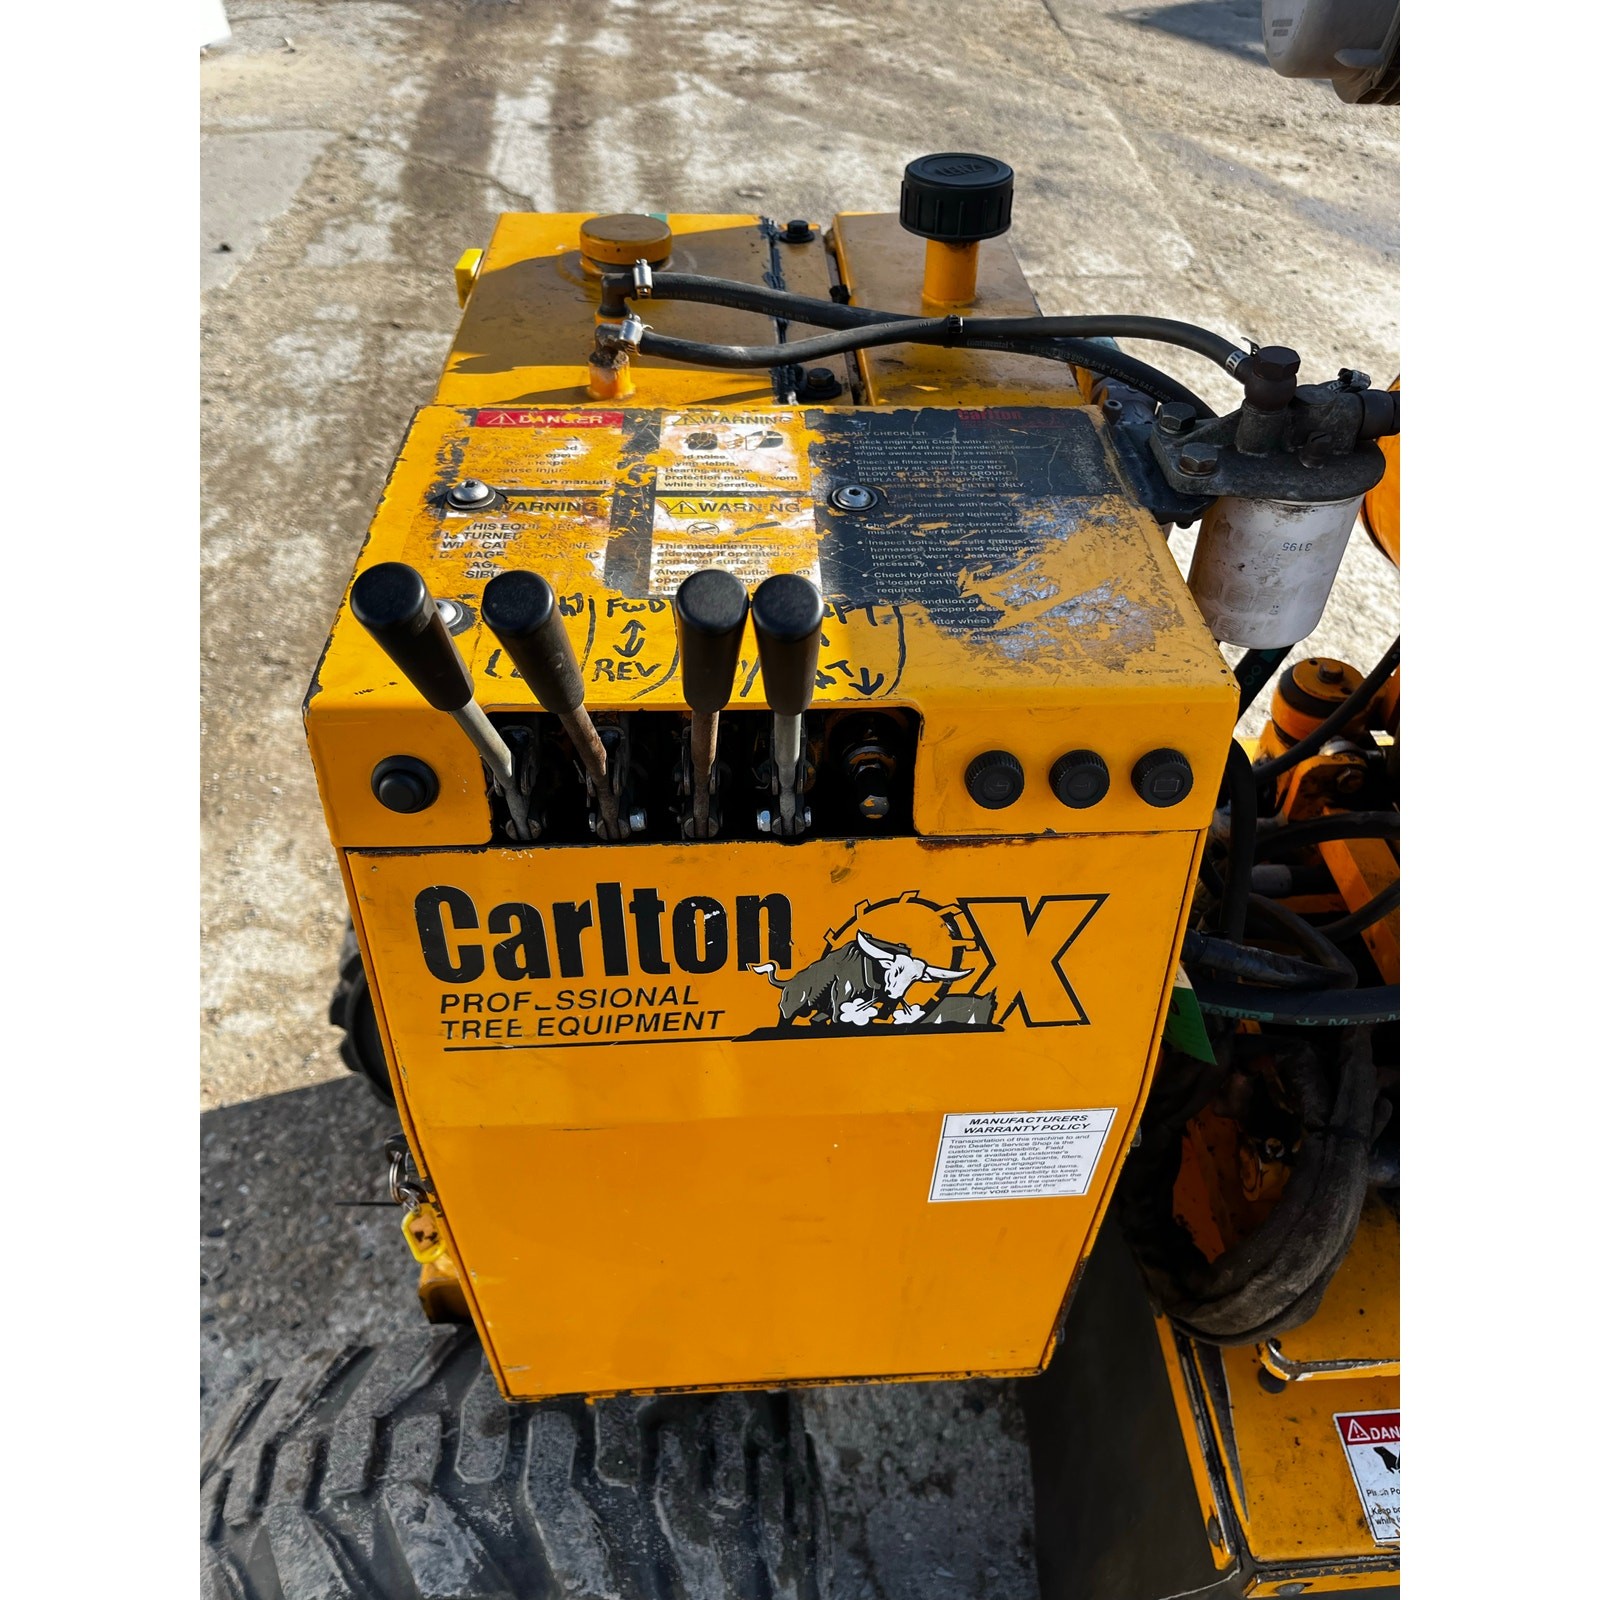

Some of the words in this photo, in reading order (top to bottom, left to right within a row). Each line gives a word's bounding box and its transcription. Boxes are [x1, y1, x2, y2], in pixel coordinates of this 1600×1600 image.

[1282, 542, 1312, 551] 3195
[592, 659, 661, 681] REV
[414, 882, 792, 983] Carlton
[442, 1018, 527, 1040] TREE
[537, 1010, 726, 1037] EQUIPMENT
[964, 1125, 1040, 1133] WARRANTY
[1041, 1123, 1091, 1131] POLICY
[969, 1115, 1089, 1125] MANUFACTURERS
